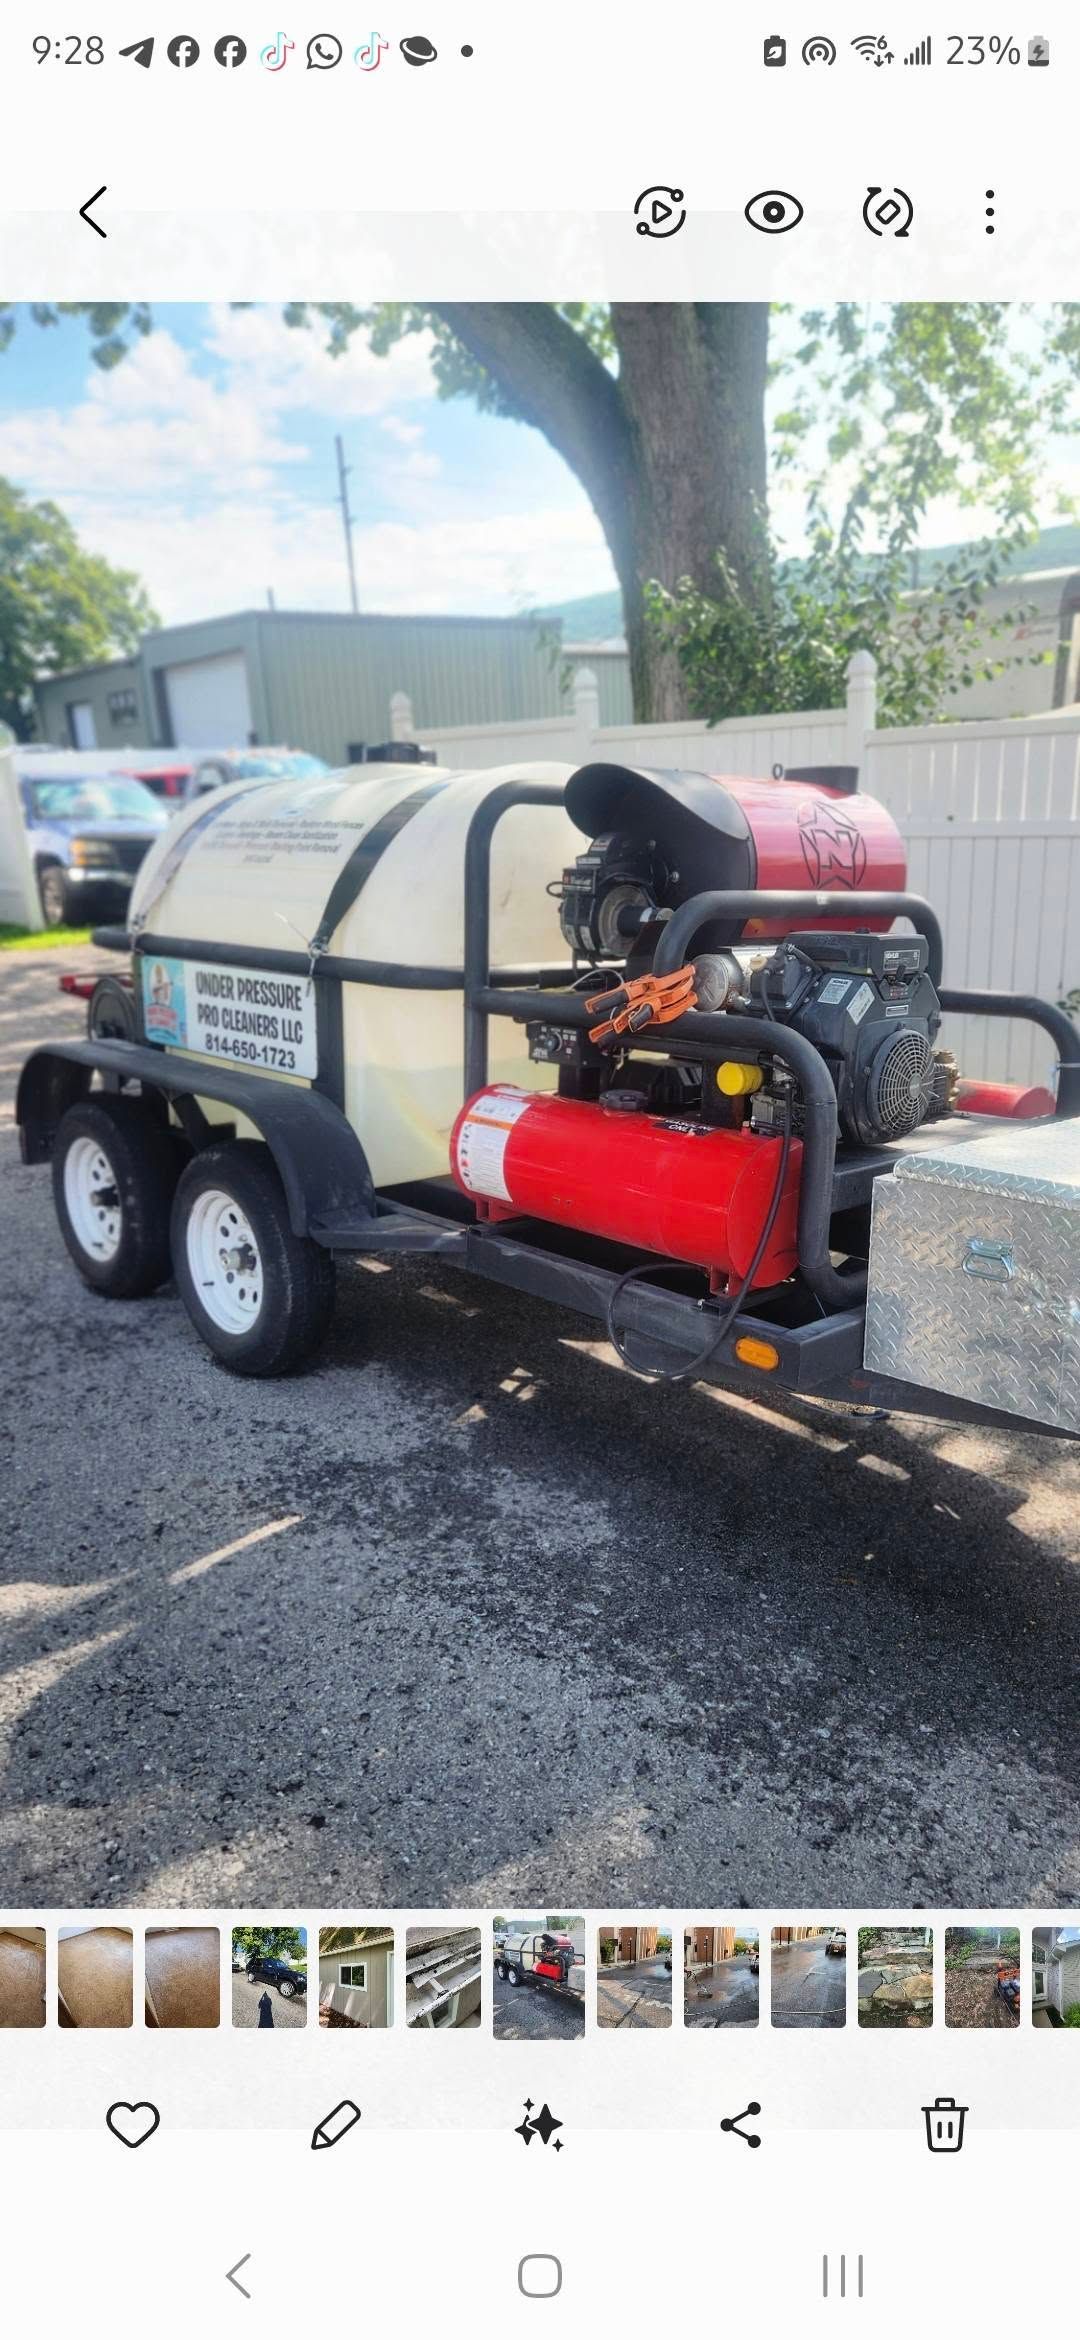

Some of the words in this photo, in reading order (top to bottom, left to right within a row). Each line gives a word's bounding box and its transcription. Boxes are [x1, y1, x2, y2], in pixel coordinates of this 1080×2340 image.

[195, 971, 235, 1001] UNDER
[237, 978, 303, 1012] PRESSURE
[197, 1003, 219, 1028] PRO
[221, 1007, 279, 1040] CLEANERS
[281, 1018, 303, 1045] LLC
[205, 1033, 296, 1070] 814-650-1723
